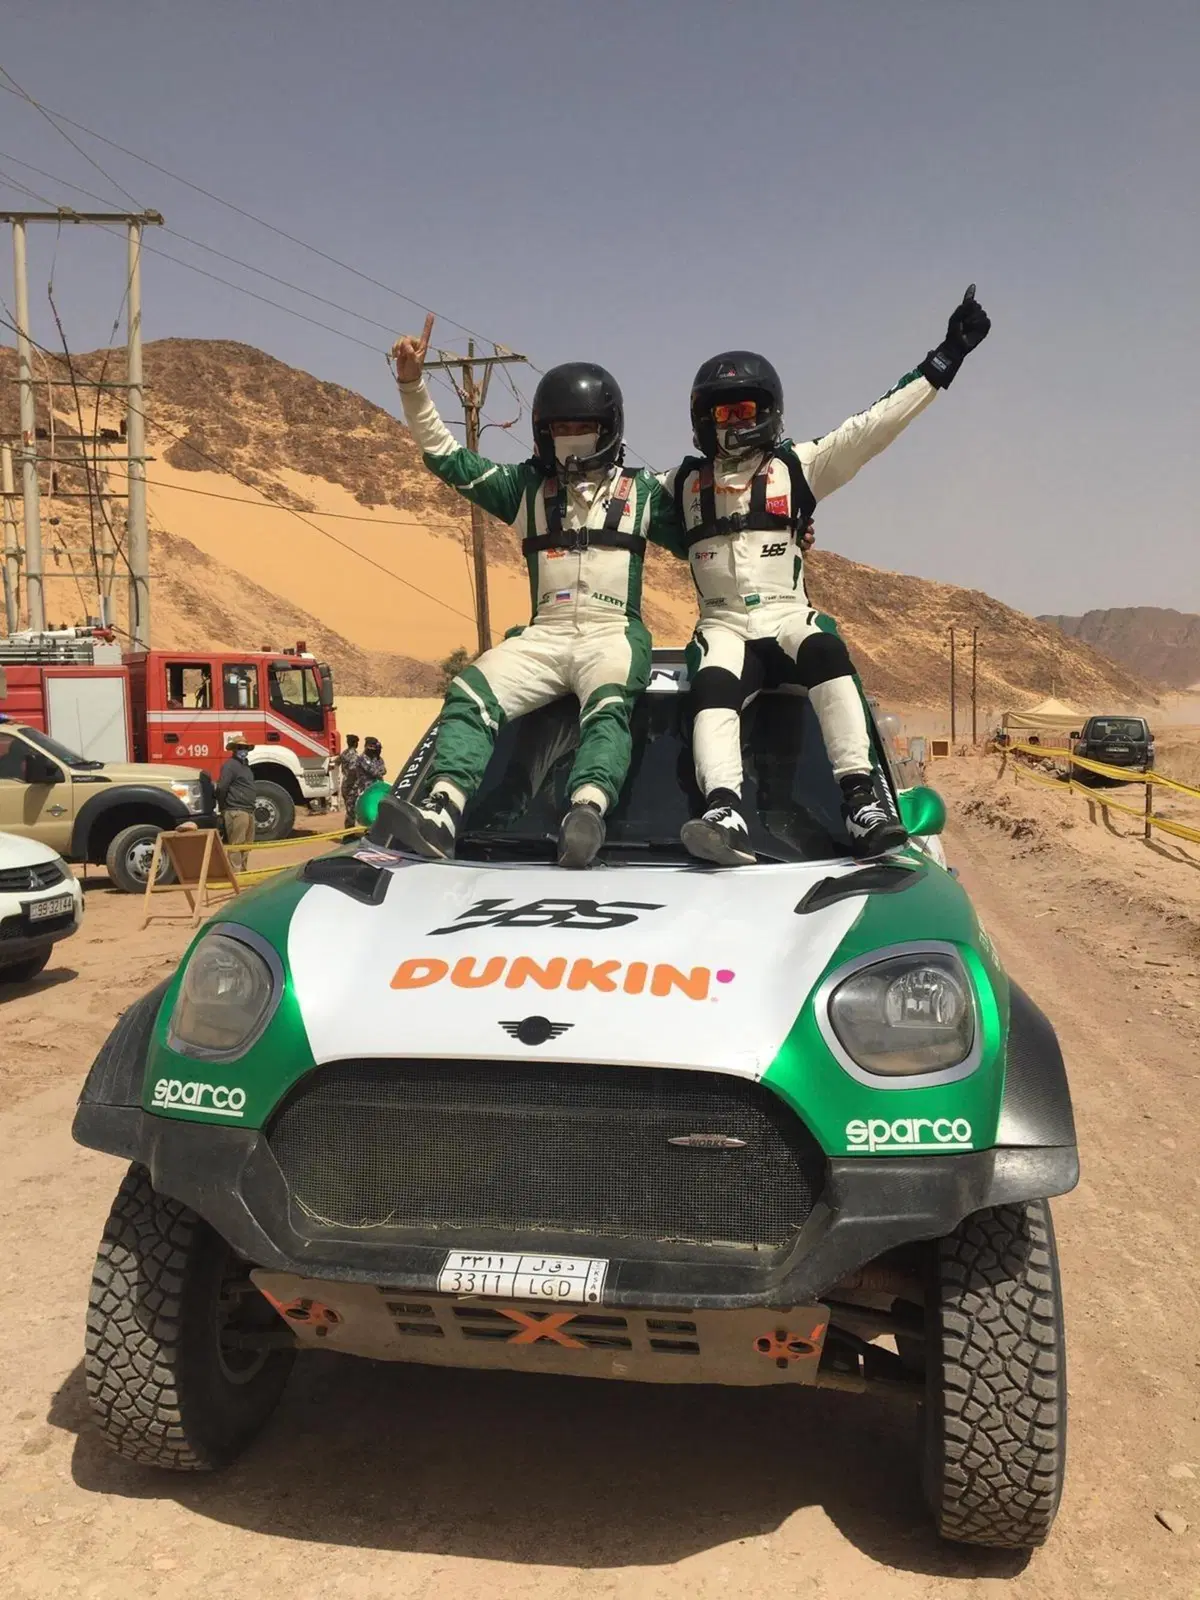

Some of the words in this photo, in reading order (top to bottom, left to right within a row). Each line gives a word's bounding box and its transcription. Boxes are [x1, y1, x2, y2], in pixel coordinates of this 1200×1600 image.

[591, 592, 625, 607] ALEXEY
[187, 744, 208, 757] 199
[154, 1078, 246, 1110] sparco
[845, 1118, 973, 1152] sparco
[451, 1272, 502, 1293] 3311
[529, 1278, 572, 1297] LGD
